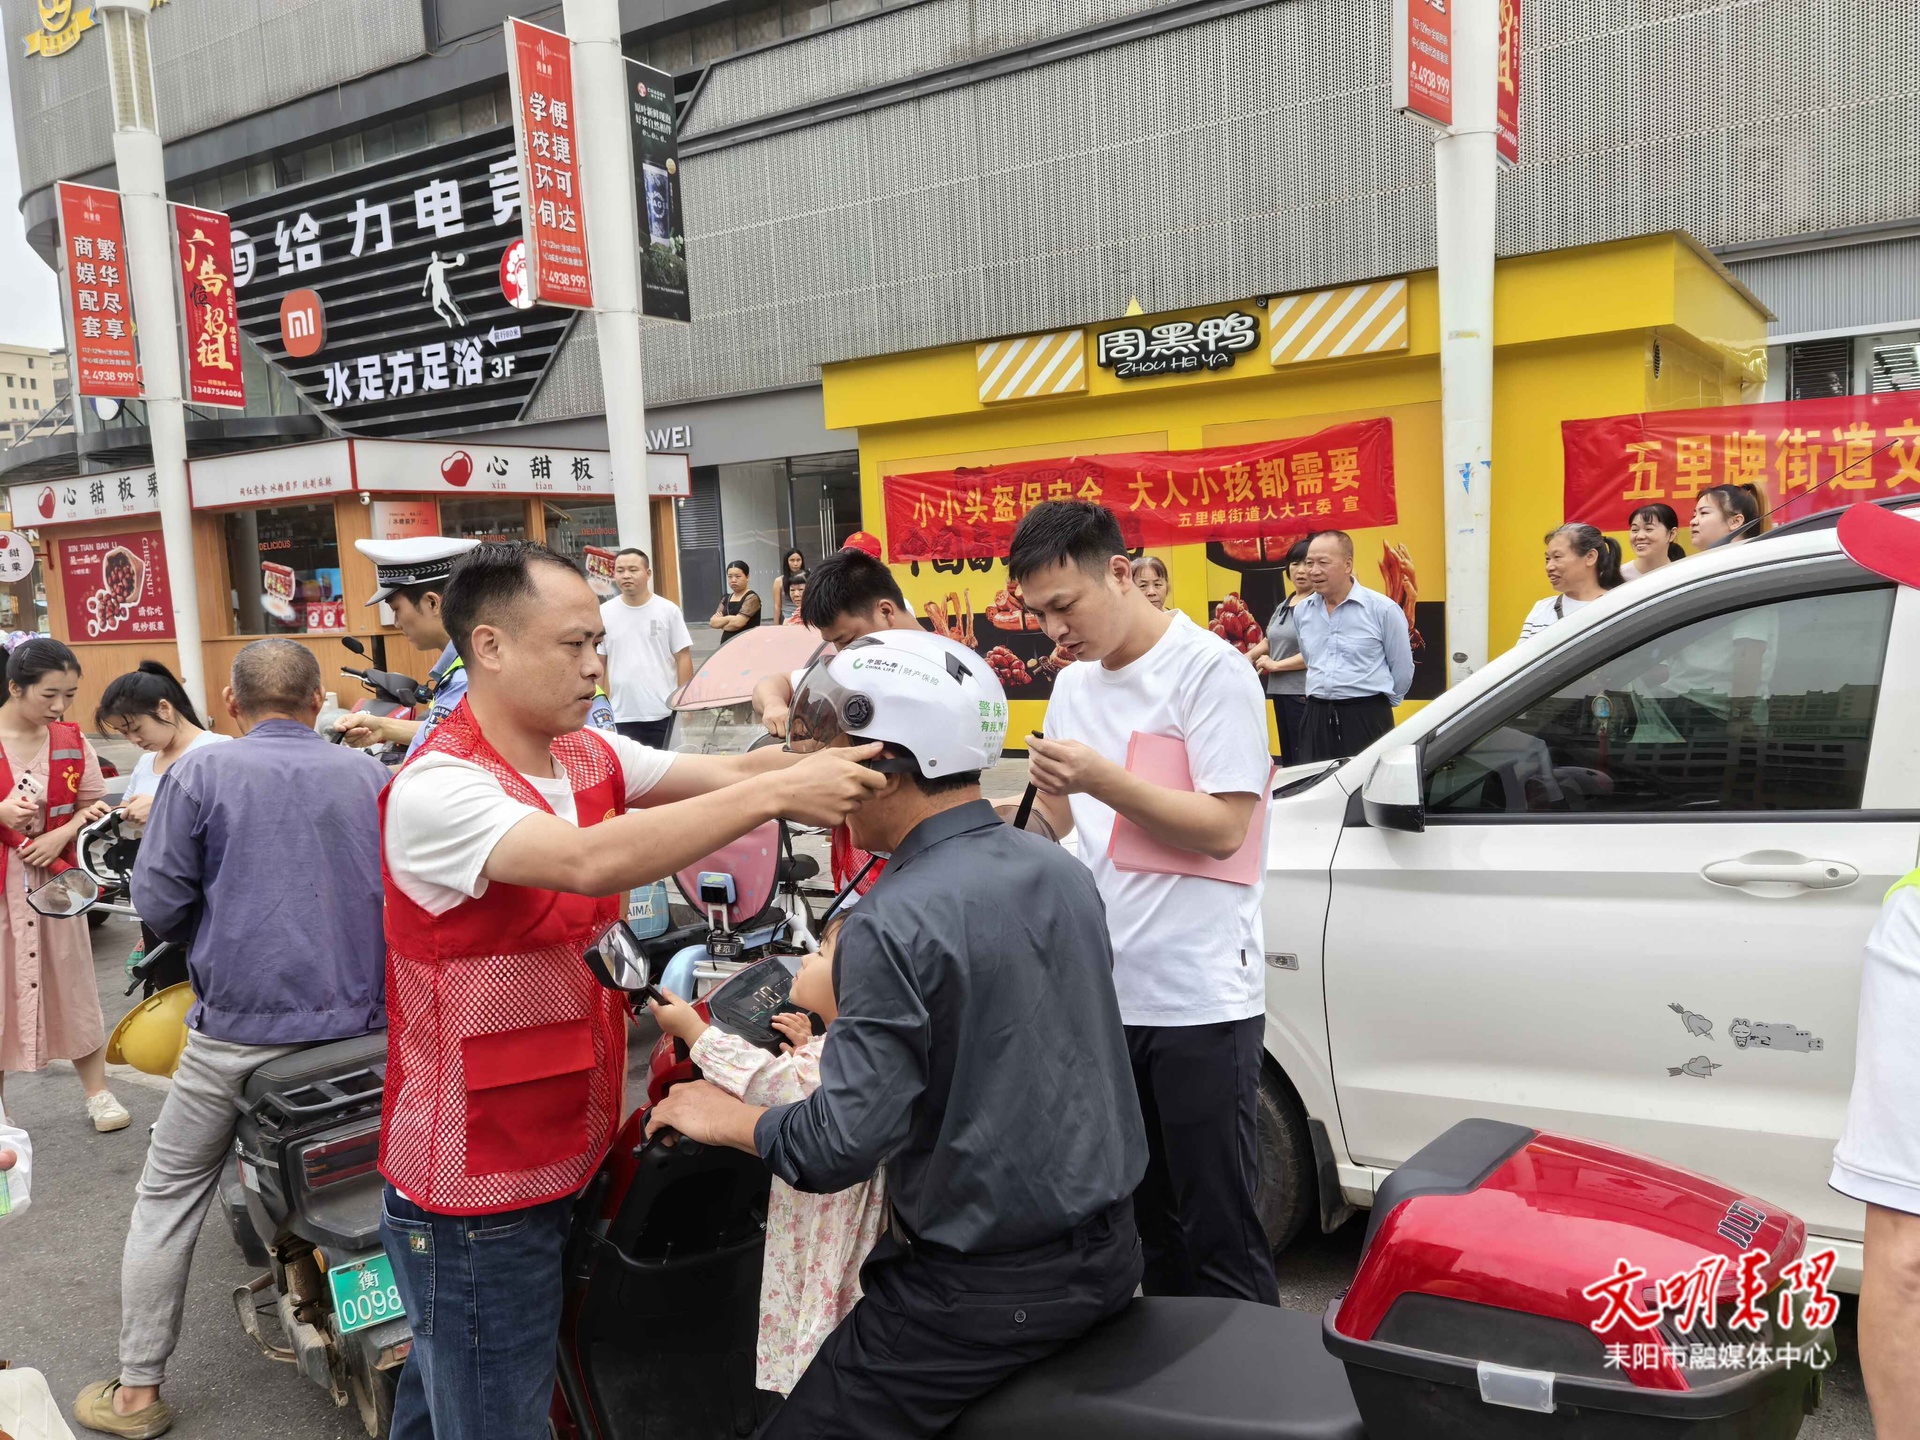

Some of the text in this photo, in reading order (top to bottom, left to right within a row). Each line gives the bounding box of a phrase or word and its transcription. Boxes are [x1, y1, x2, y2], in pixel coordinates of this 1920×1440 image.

[1419, 65, 1436, 89] 4938
[1437, 73, 1450, 95] 999
[529, 91, 561, 228] 学校环伺
[549, 97, 577, 232] 便捷可达
[73, 235, 102, 340] 商娱配套
[96, 237, 126, 340] 繁华尽享
[549, 270, 570, 286] 4938
[570, 274, 586, 288] 999
[1098, 312, 1256, 364] 周黑鸭
[92, 370, 135, 382] 4938 999
[323, 336, 485, 408] 水足方足浴
[490, 355, 517, 379] 3F
[1117, 361, 1167, 376] ZHOU
[1202, 352, 1229, 367] YA
[193, 385, 242, 398] 13487544006
[486, 455, 614, 482] 心甜板
[1622, 417, 1920, 501] 五里牌街道交
[491, 480, 593, 491] xin tian ban
[912, 475, 1104, 528] 小小头盔保安全
[1128, 447, 1362, 512] 大人小孩都需要
[1177, 494, 1361, 528] 五里牌街道人大工委 宣
[67, 544, 78, 553] XIN
[80, 543, 94, 552] TIAN
[96, 542, 110, 550] BAN
[259, 540, 292, 551] DELICIOUS
[141, 537, 155, 597] CHESTNUT
[867, 658, 899, 669] 中国人寿
[903, 667, 940, 686] 财产保险
[358, 1269, 380, 1291] 衡
